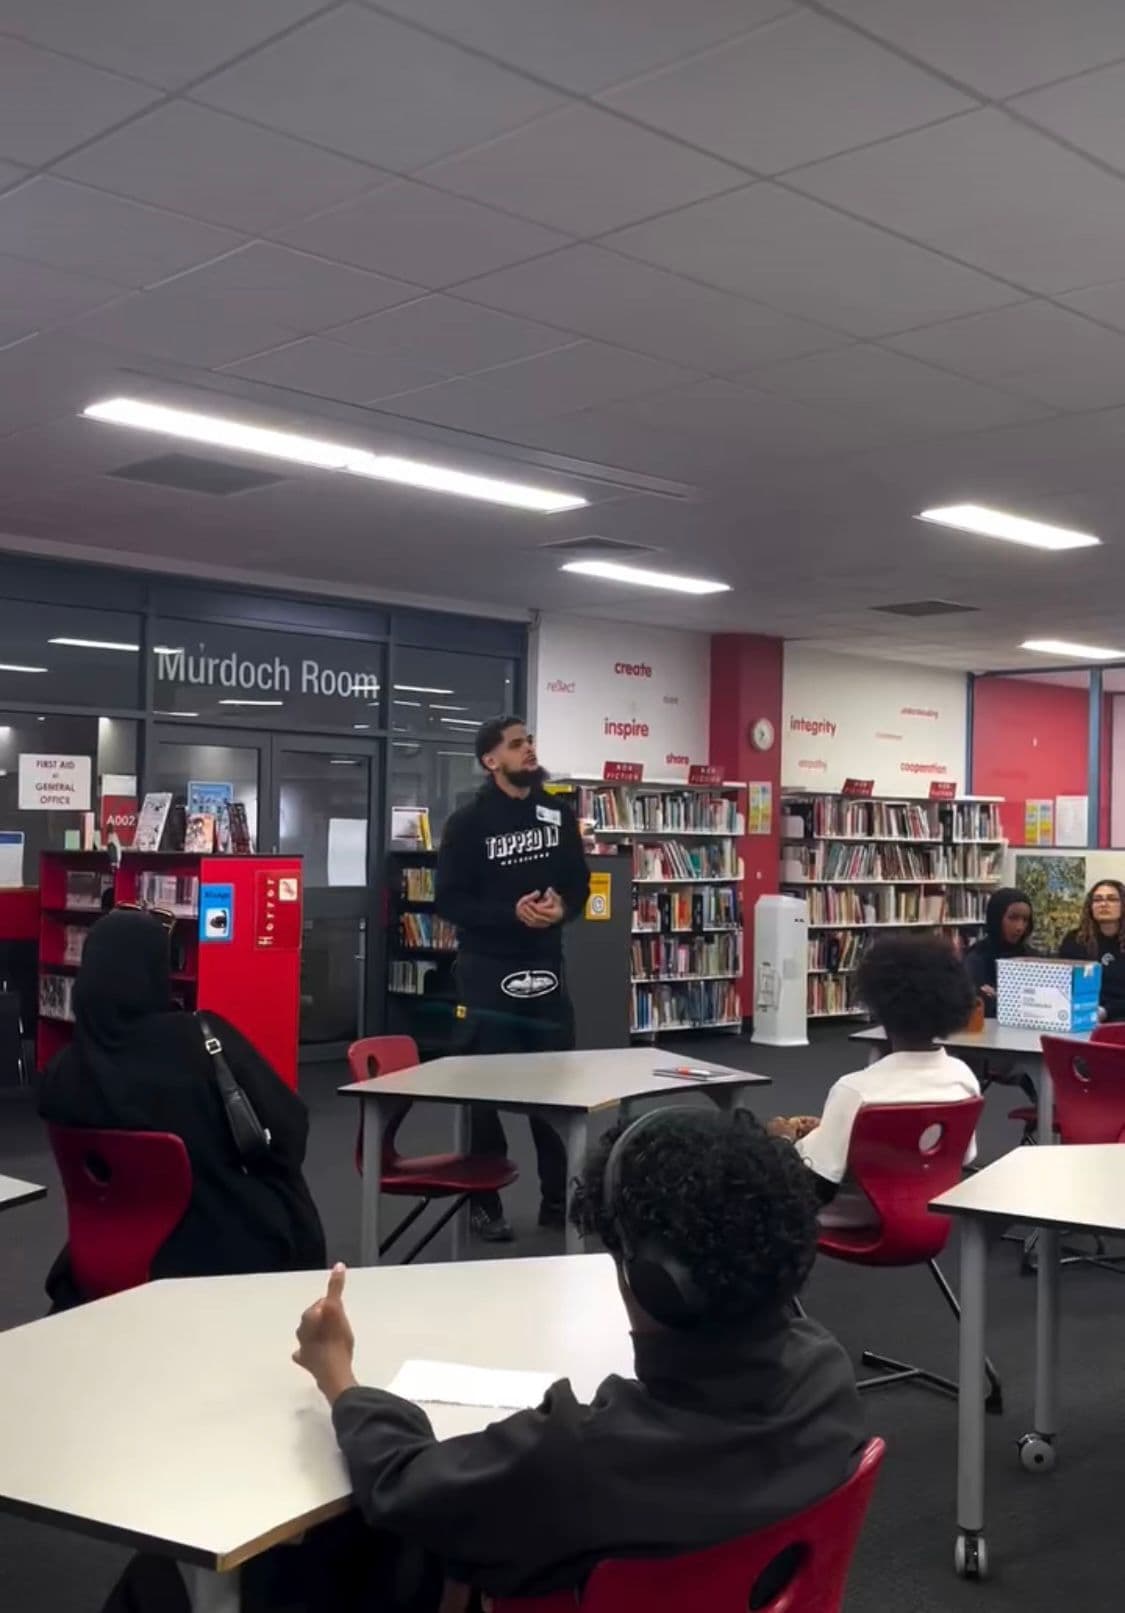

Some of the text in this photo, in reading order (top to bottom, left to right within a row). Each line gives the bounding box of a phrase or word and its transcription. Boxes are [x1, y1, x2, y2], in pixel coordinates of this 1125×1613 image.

[158, 648, 377, 699] Murdoch Room
[614, 661, 652, 678] create
[604, 717, 649, 740] inspire
[790, 715, 837, 737] integrity
[36, 760, 76, 770] FIRST AID
[35, 783, 76, 793] GENERAL
[40, 796, 71, 806] OFFICE
[107, 815, 136, 827] A002
[485, 825, 560, 860] TAPPED IN
[257, 877, 275, 946] Horror
